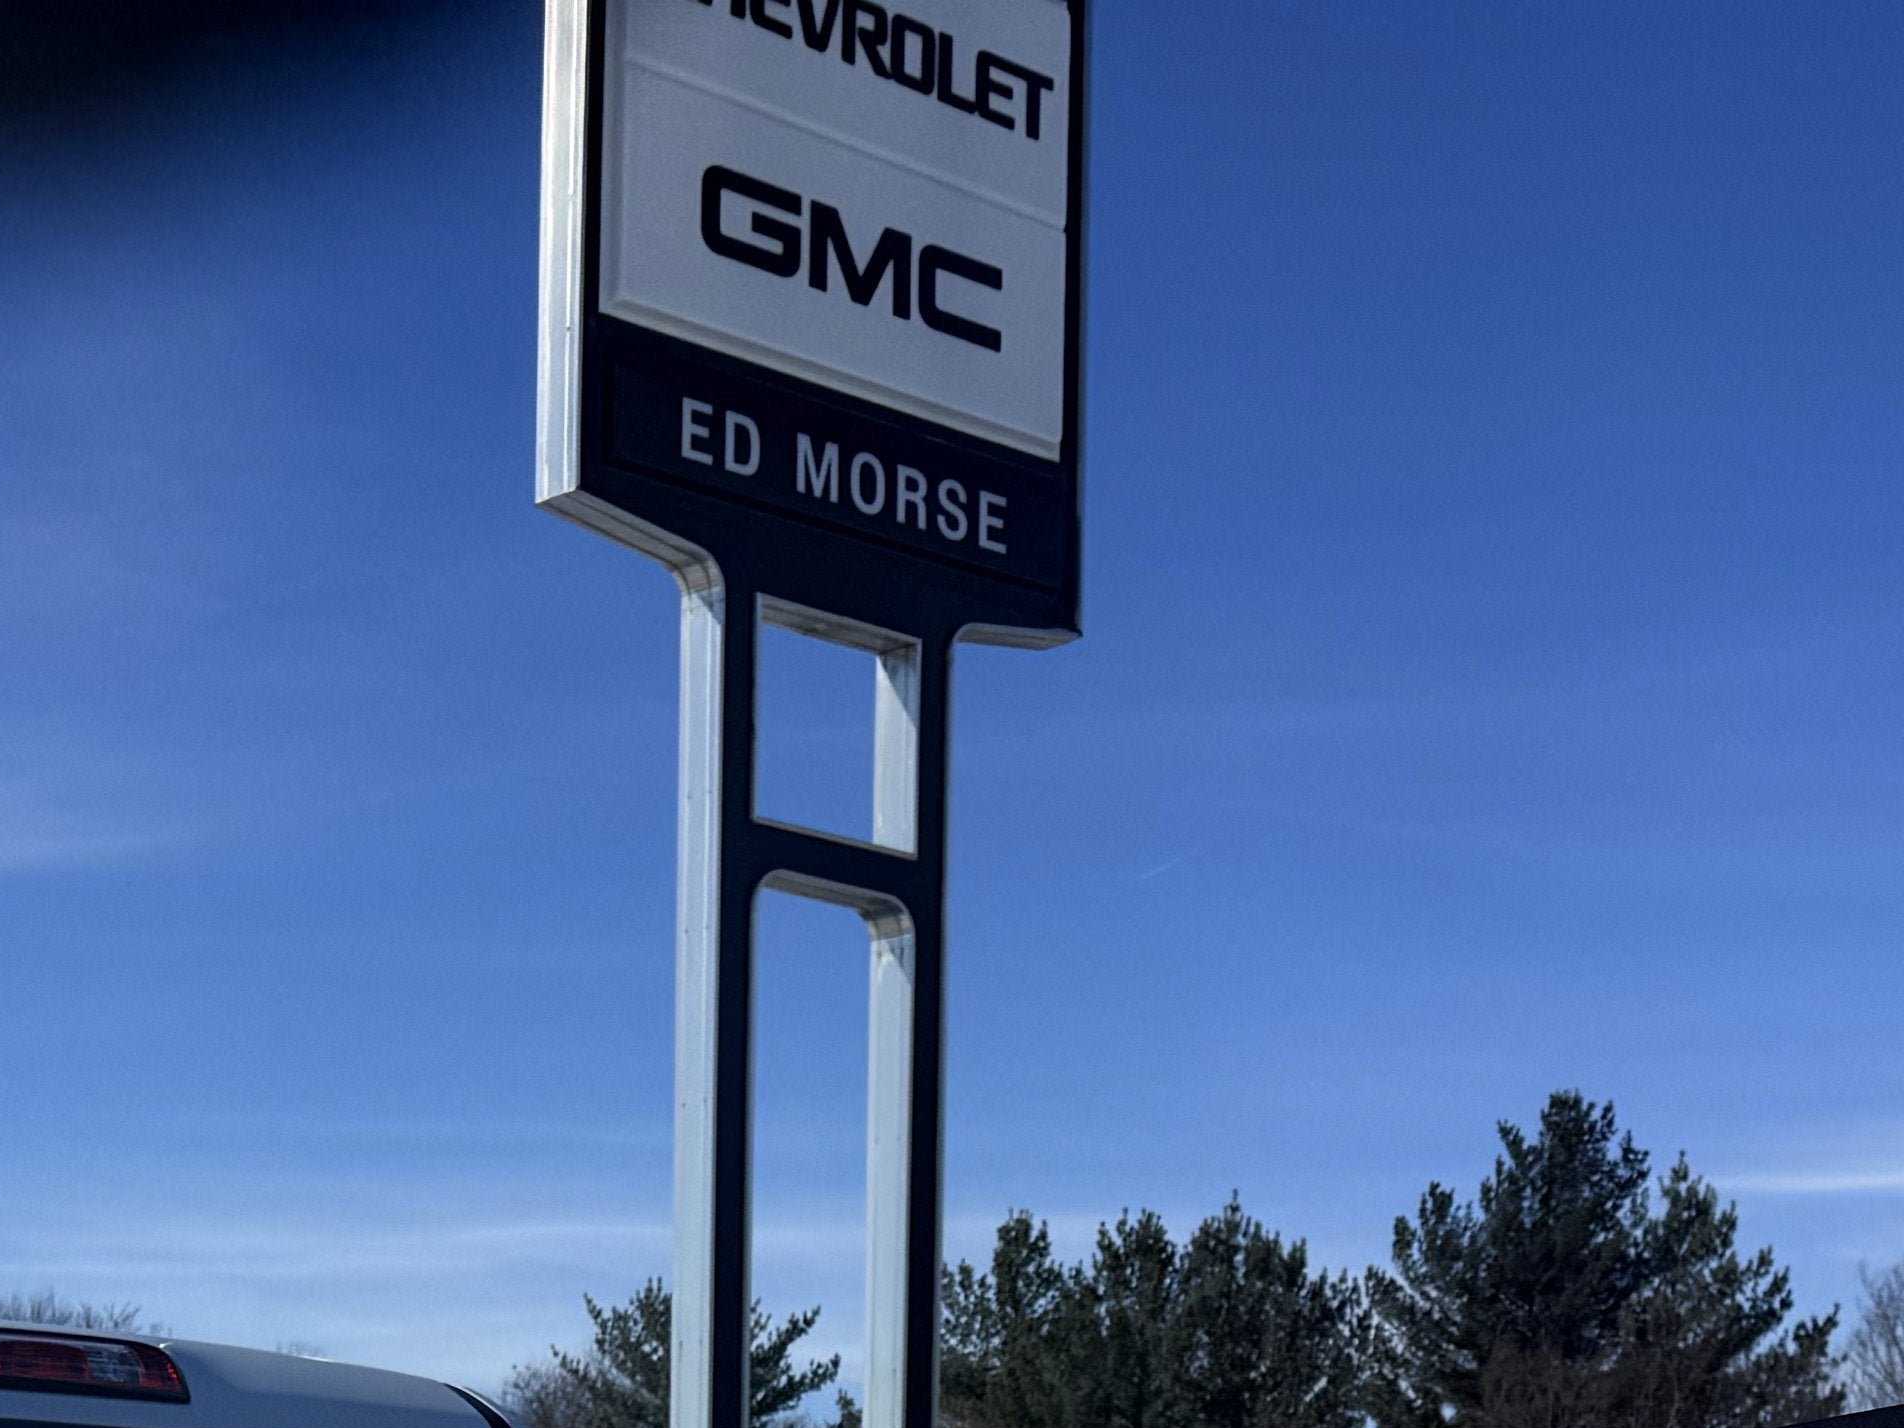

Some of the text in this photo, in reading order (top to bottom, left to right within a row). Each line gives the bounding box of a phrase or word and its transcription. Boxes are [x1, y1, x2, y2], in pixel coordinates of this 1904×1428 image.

[696, 0, 1054, 141] EVROLET
[701, 164, 1003, 353] GMC
[680, 396, 1008, 554] ED MORSE
